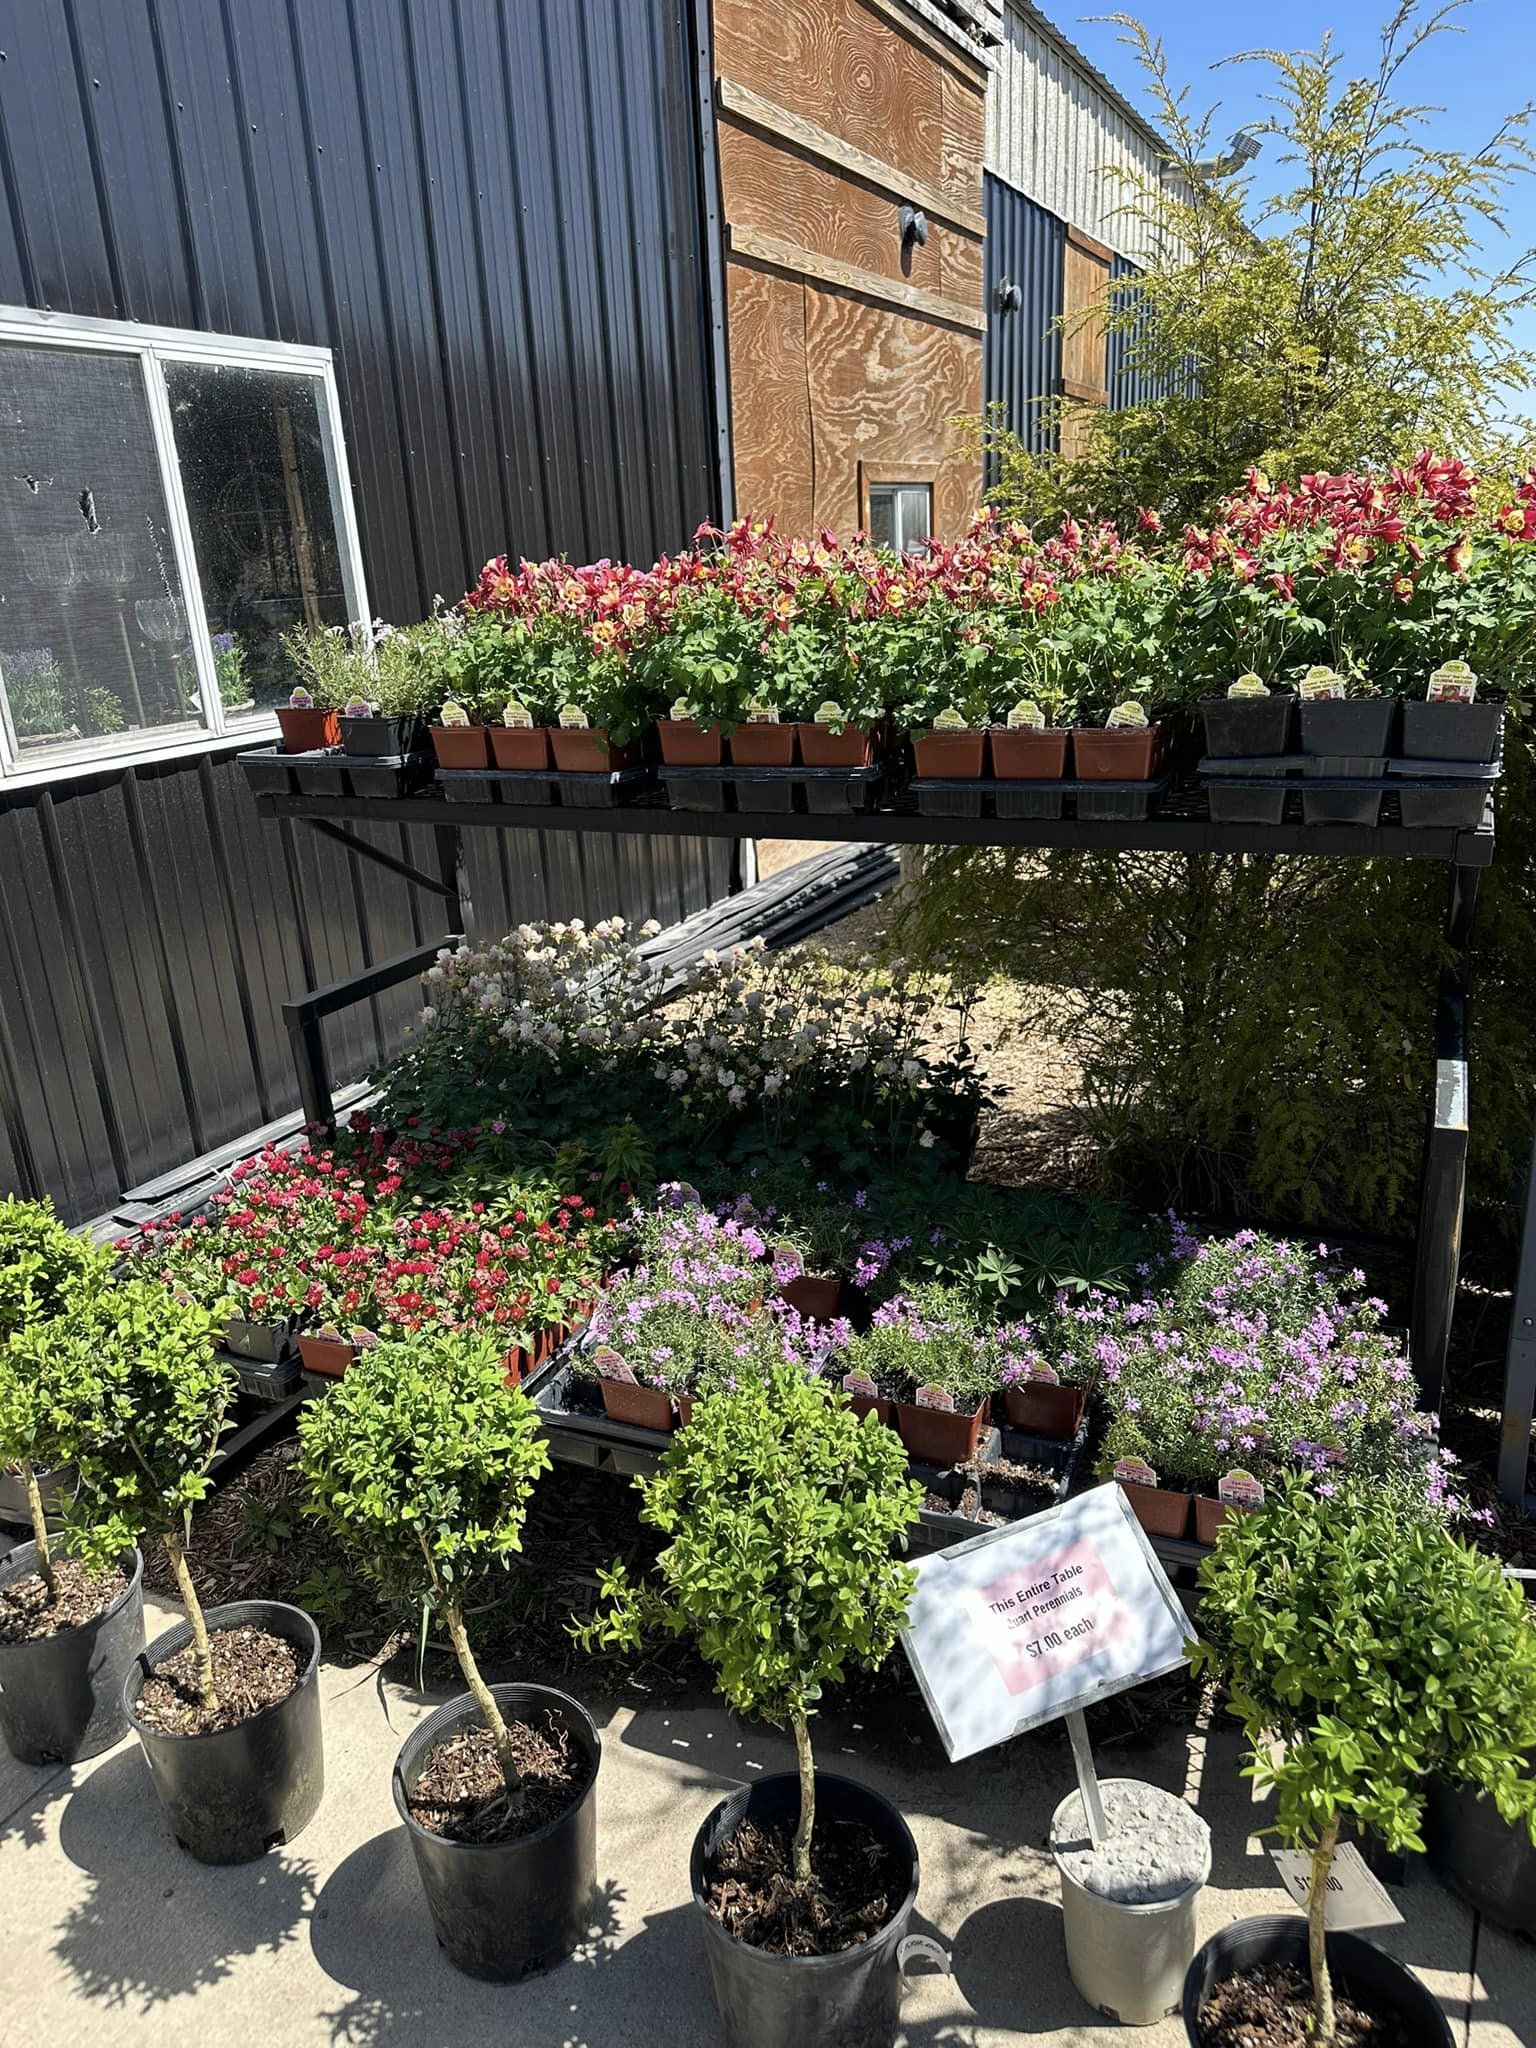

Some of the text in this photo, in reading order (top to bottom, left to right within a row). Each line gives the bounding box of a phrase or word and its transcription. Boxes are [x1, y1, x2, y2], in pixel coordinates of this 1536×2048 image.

[988, 1565, 1083, 1614] This Entire Table
[1032, 1586, 1083, 1617] Perennials
[1026, 1617, 1094, 1658] $7.00 each
